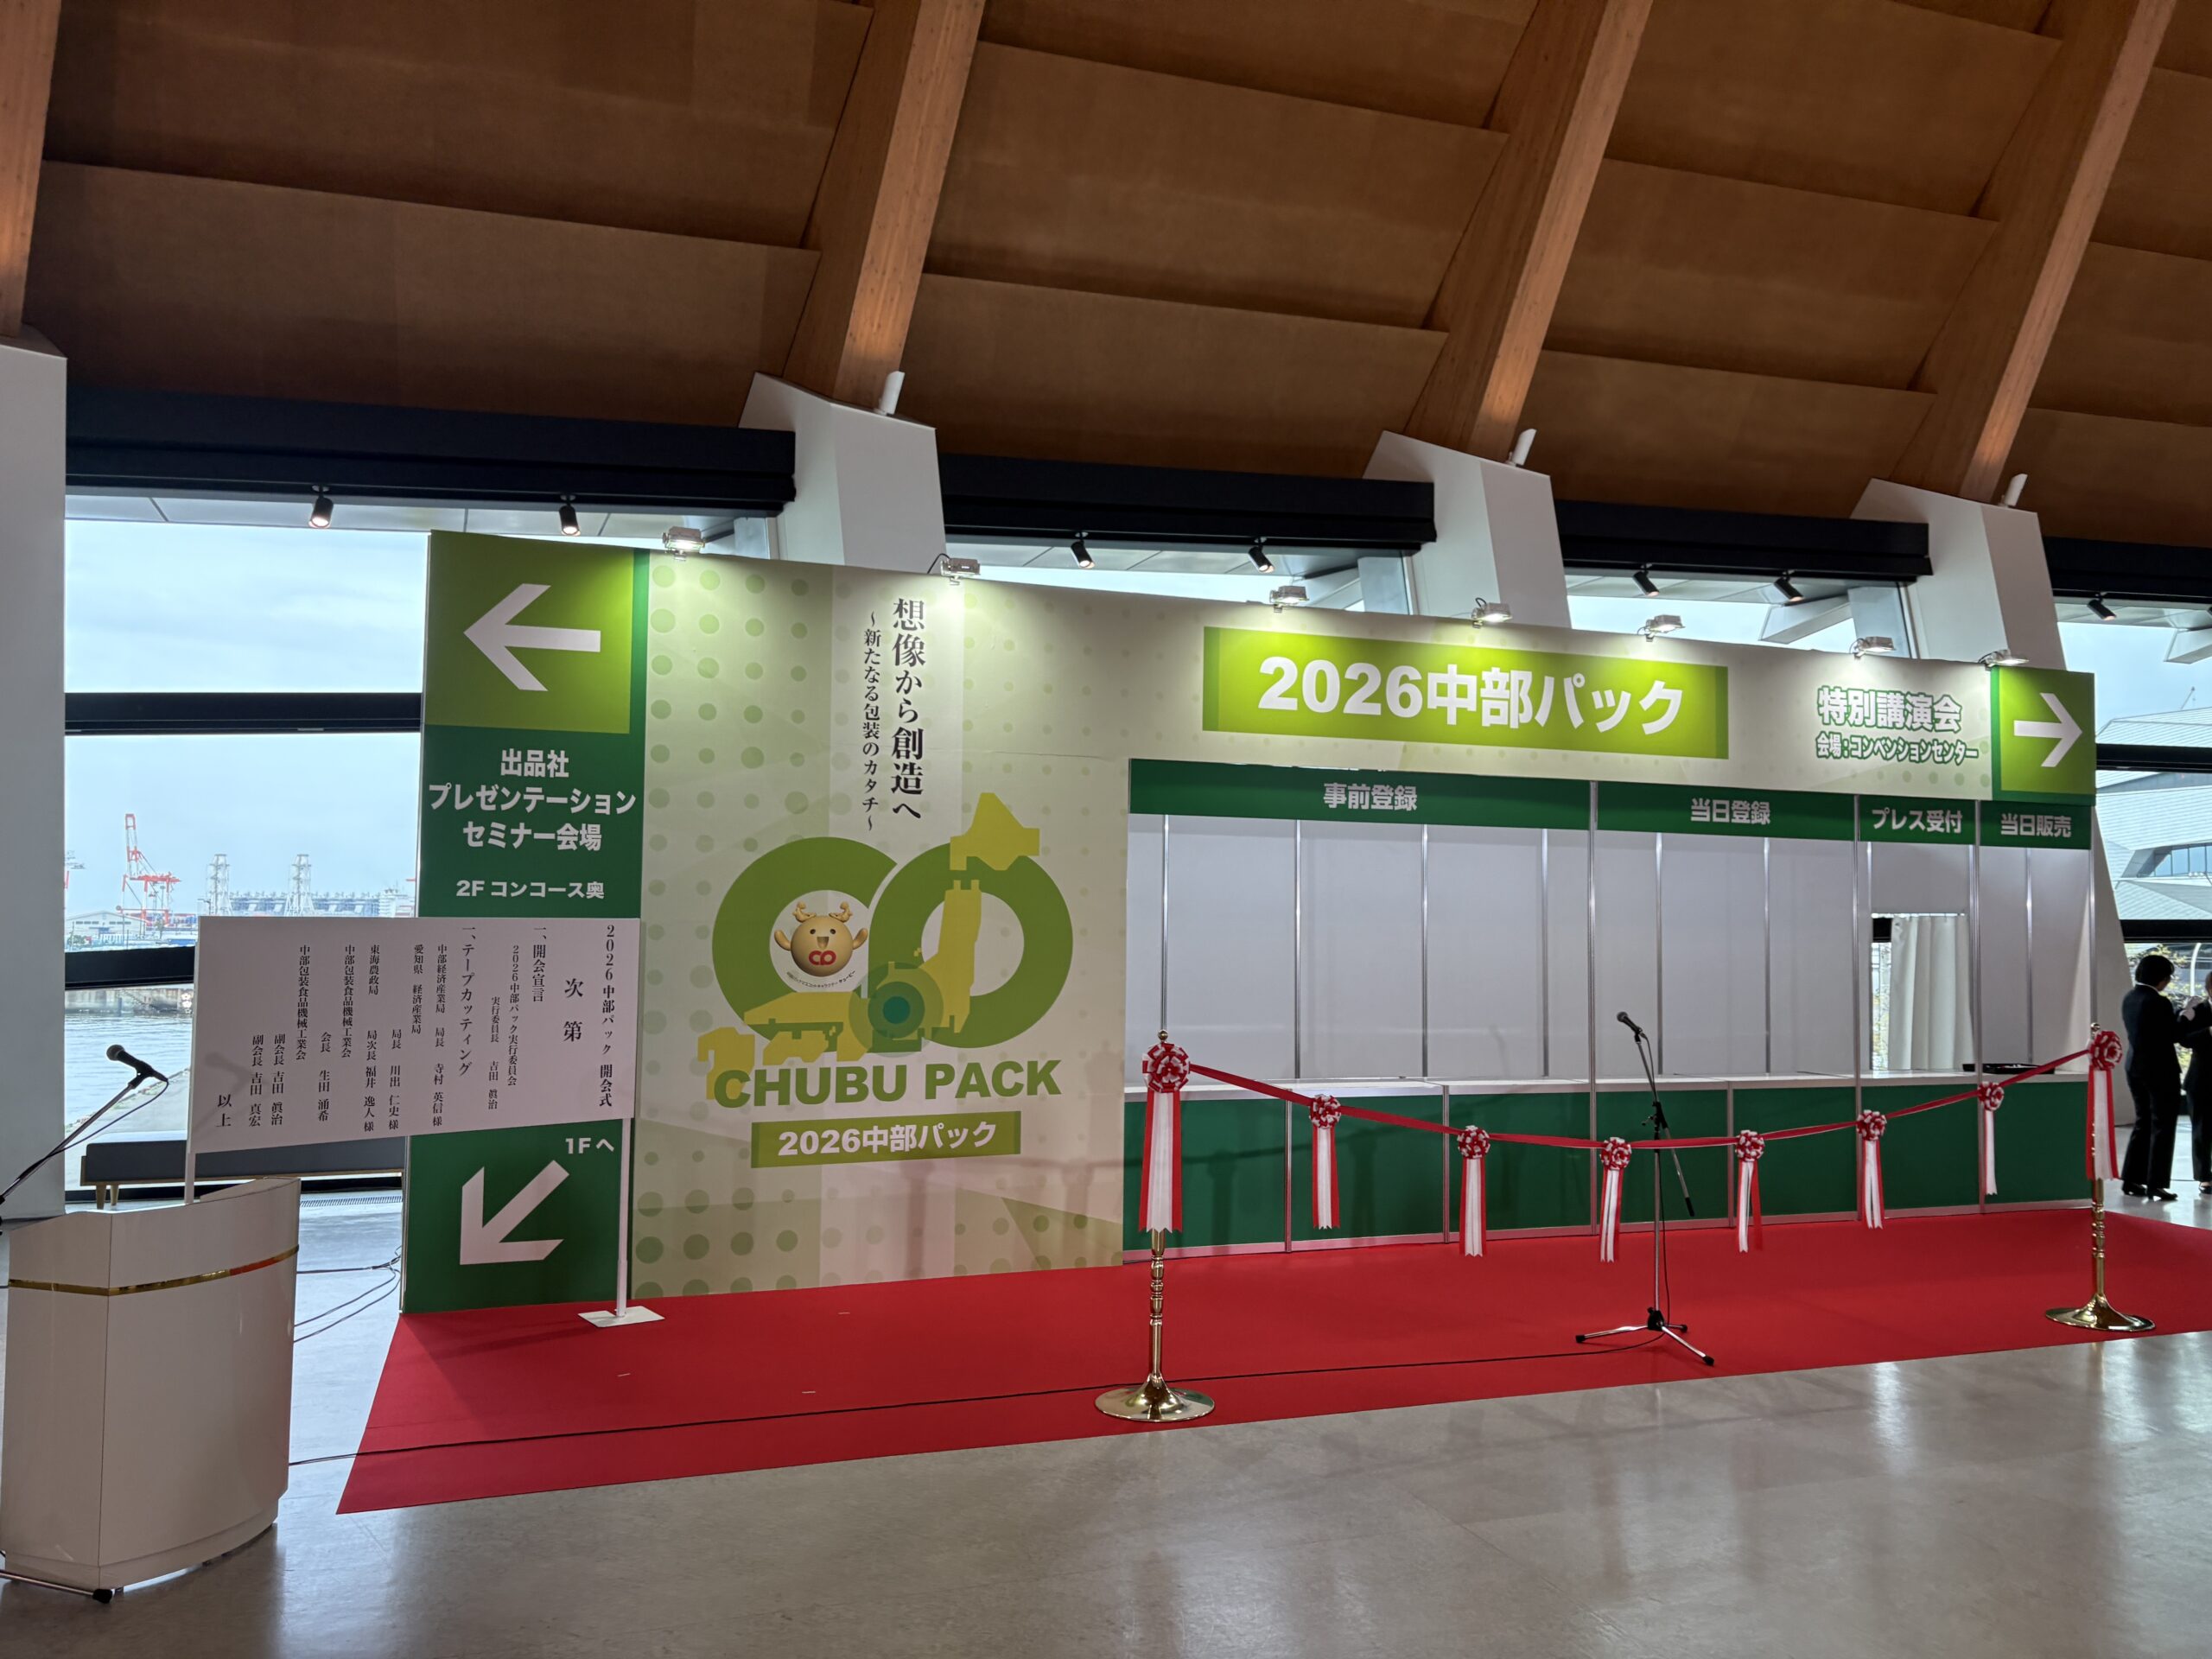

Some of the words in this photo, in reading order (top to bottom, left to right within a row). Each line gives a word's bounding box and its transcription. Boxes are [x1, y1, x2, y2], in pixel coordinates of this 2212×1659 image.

[890, 598, 925, 819] 想像から創造へ
[1258, 656, 1683, 735] 2026中部パック
[1817, 686, 1961, 733] 特別講演会
[499, 748, 569, 778] 出品社
[428, 783, 636, 816] プレゼンテーション
[1323, 783, 1418, 811] 事前登録
[1690, 798, 1771, 825] 当日登録
[462, 822, 602, 851] セミナー会場
[1872, 807, 1963, 834] プレス受付
[2000, 813, 2071, 838] 当日販売
[456, 880, 485, 898] 2F
[491, 880, 605, 899] コンコース奥
[368, 944, 379, 995] 東海農政局
[414, 944, 423, 975] 愛知県
[435, 944, 447, 1014] 中部経済産業局
[602, 925, 615, 1055] 2026中部パック
[296, 944, 310, 1060] 中部包装食品機械工業会
[341, 944, 355, 1058] 中部包装食品機械工業会
[411, 984, 423, 1034] 経済産業局
[507, 944, 519, 1086] 2026中部パック実行委員会
[491, 996, 500, 1043] 実行委員長
[251, 1034, 264, 1067] 副会長
[273, 1033, 286, 1065] 副会長
[321, 1031, 332, 1053] 会長
[366, 1030, 378, 1061] 局次長
[391, 1029, 402, 1050] 局長
[435, 1027, 445, 1048] 局長
[600, 1065, 613, 1107] 開会式
[713, 1065, 907, 1109] CHUBU
[925, 1059, 1062, 1100] PACK
[778, 1121, 997, 1156] 2026中部パック
